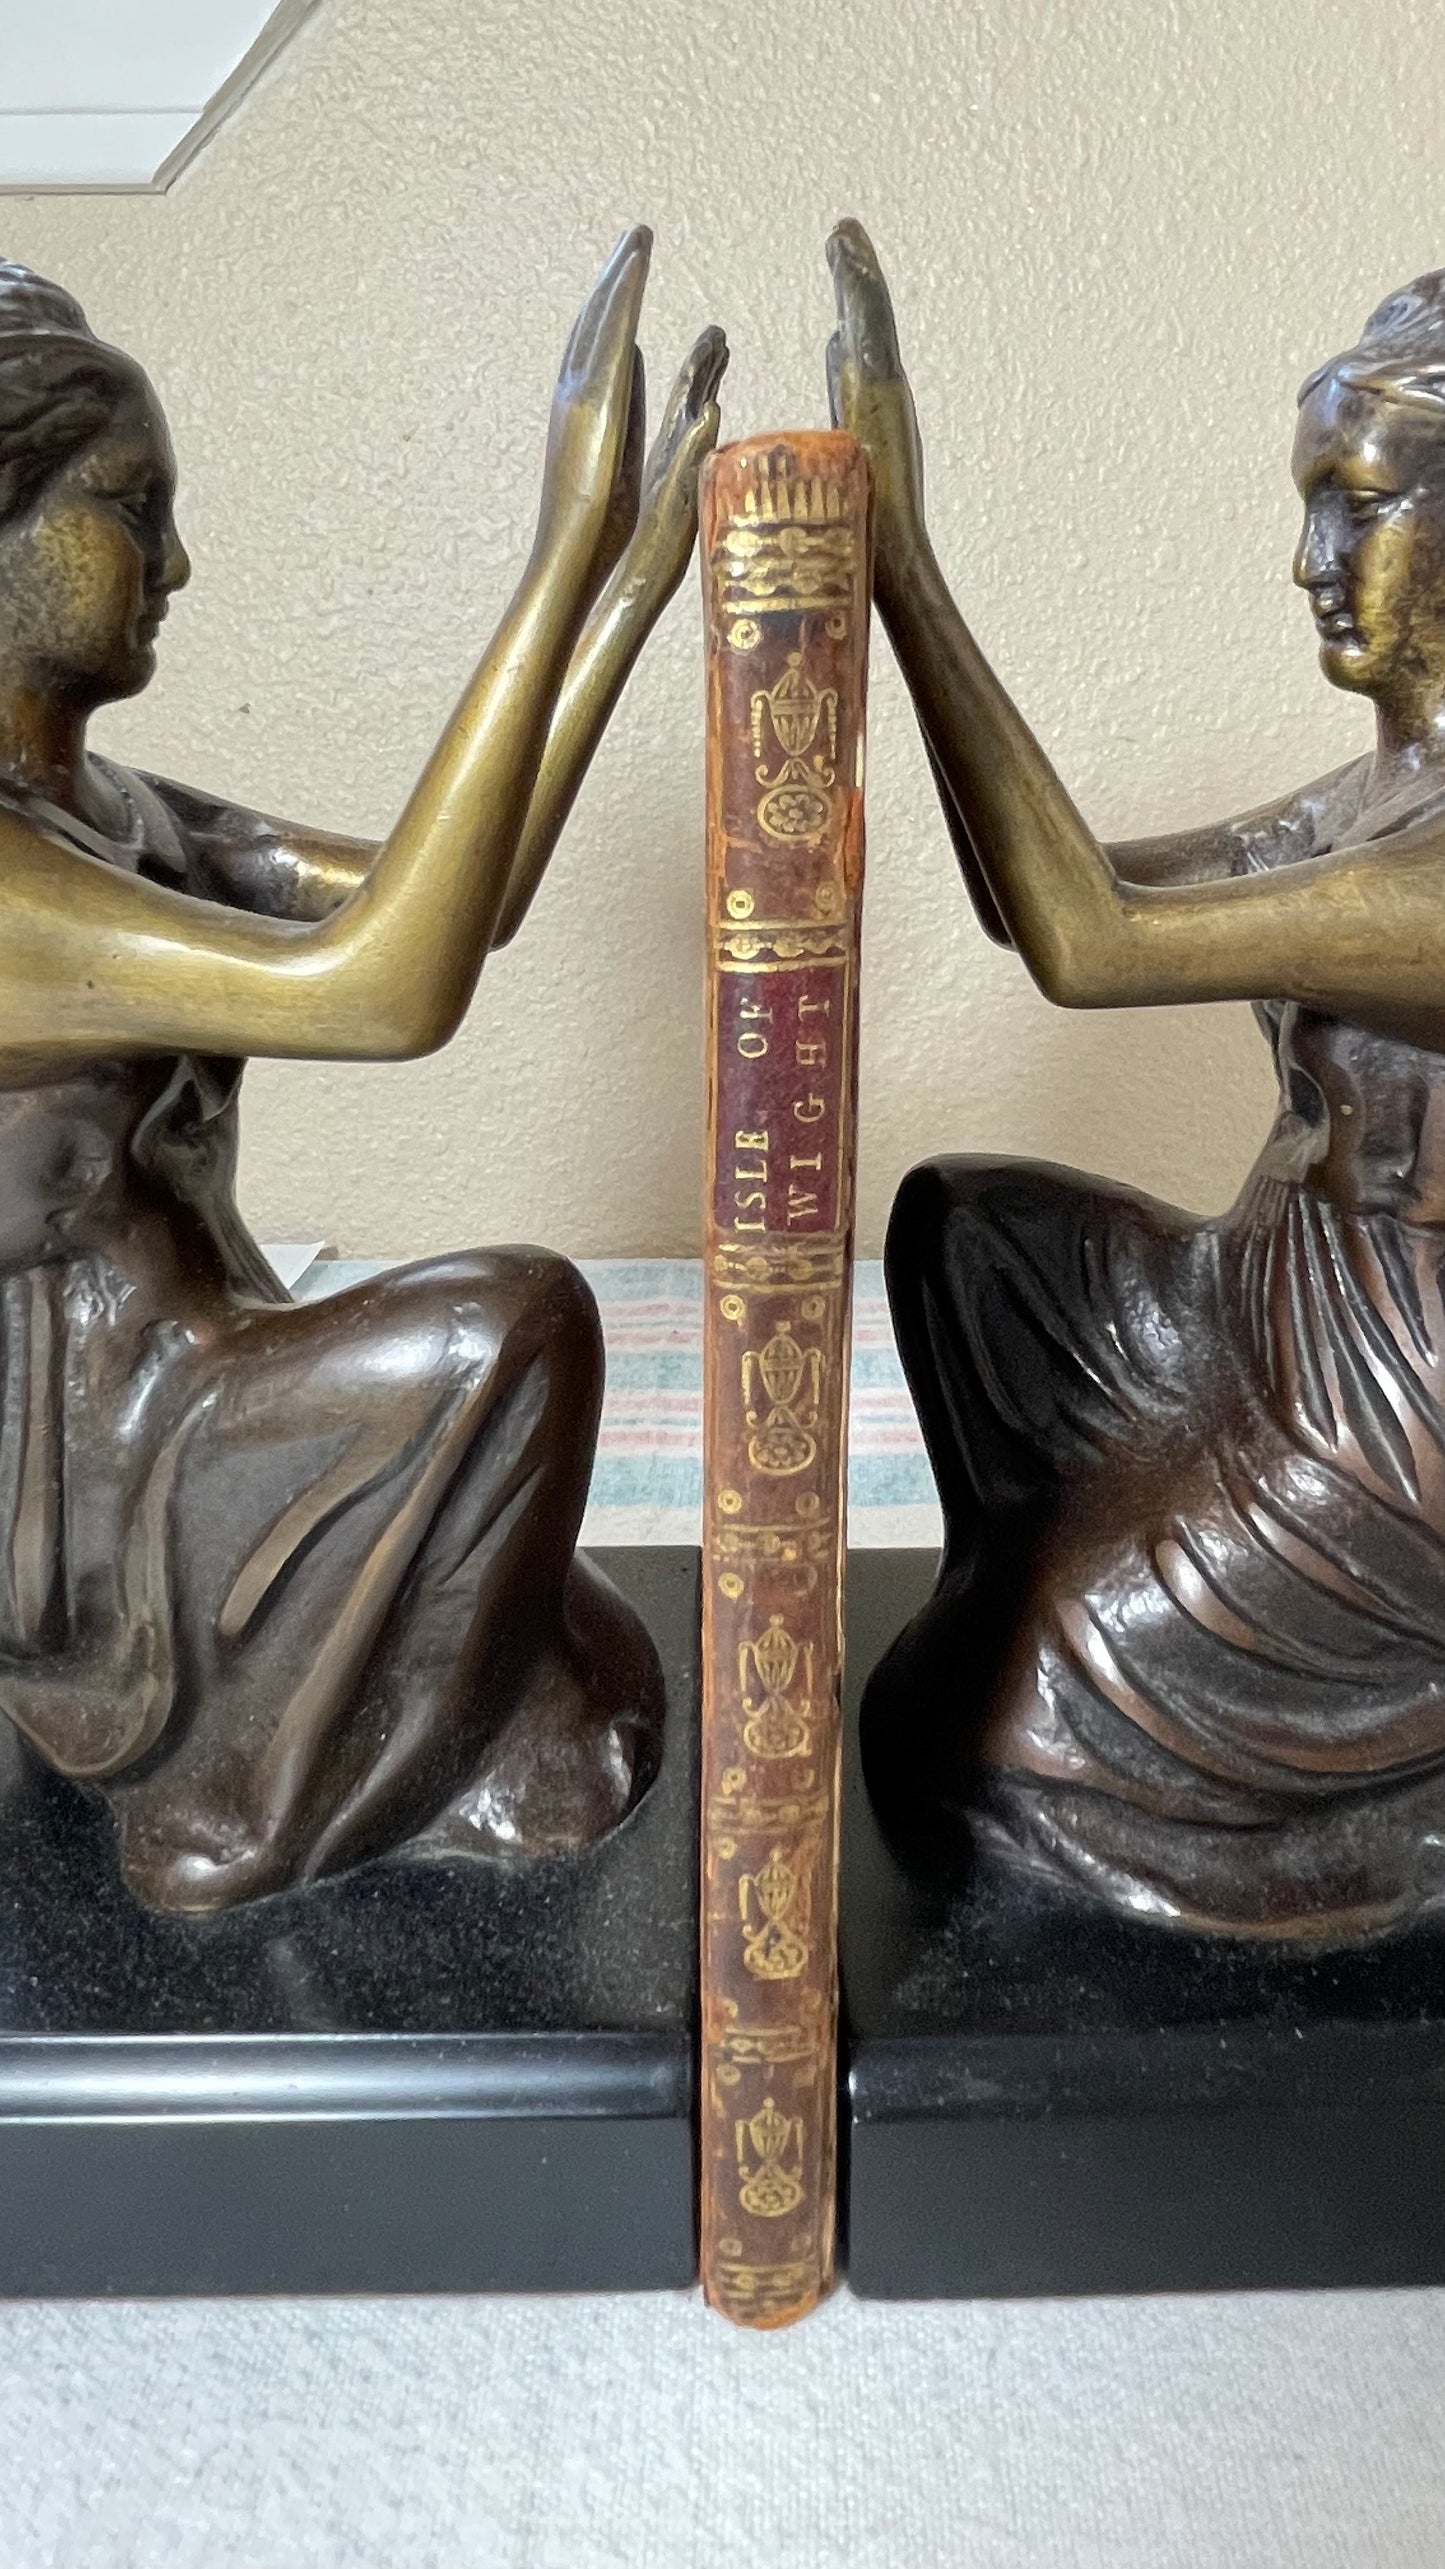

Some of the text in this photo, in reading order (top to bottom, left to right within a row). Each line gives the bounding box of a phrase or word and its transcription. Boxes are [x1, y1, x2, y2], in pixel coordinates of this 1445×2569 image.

[734, 997, 773, 1233] ISLE OF
[786, 994, 830, 1226] WIGHT
